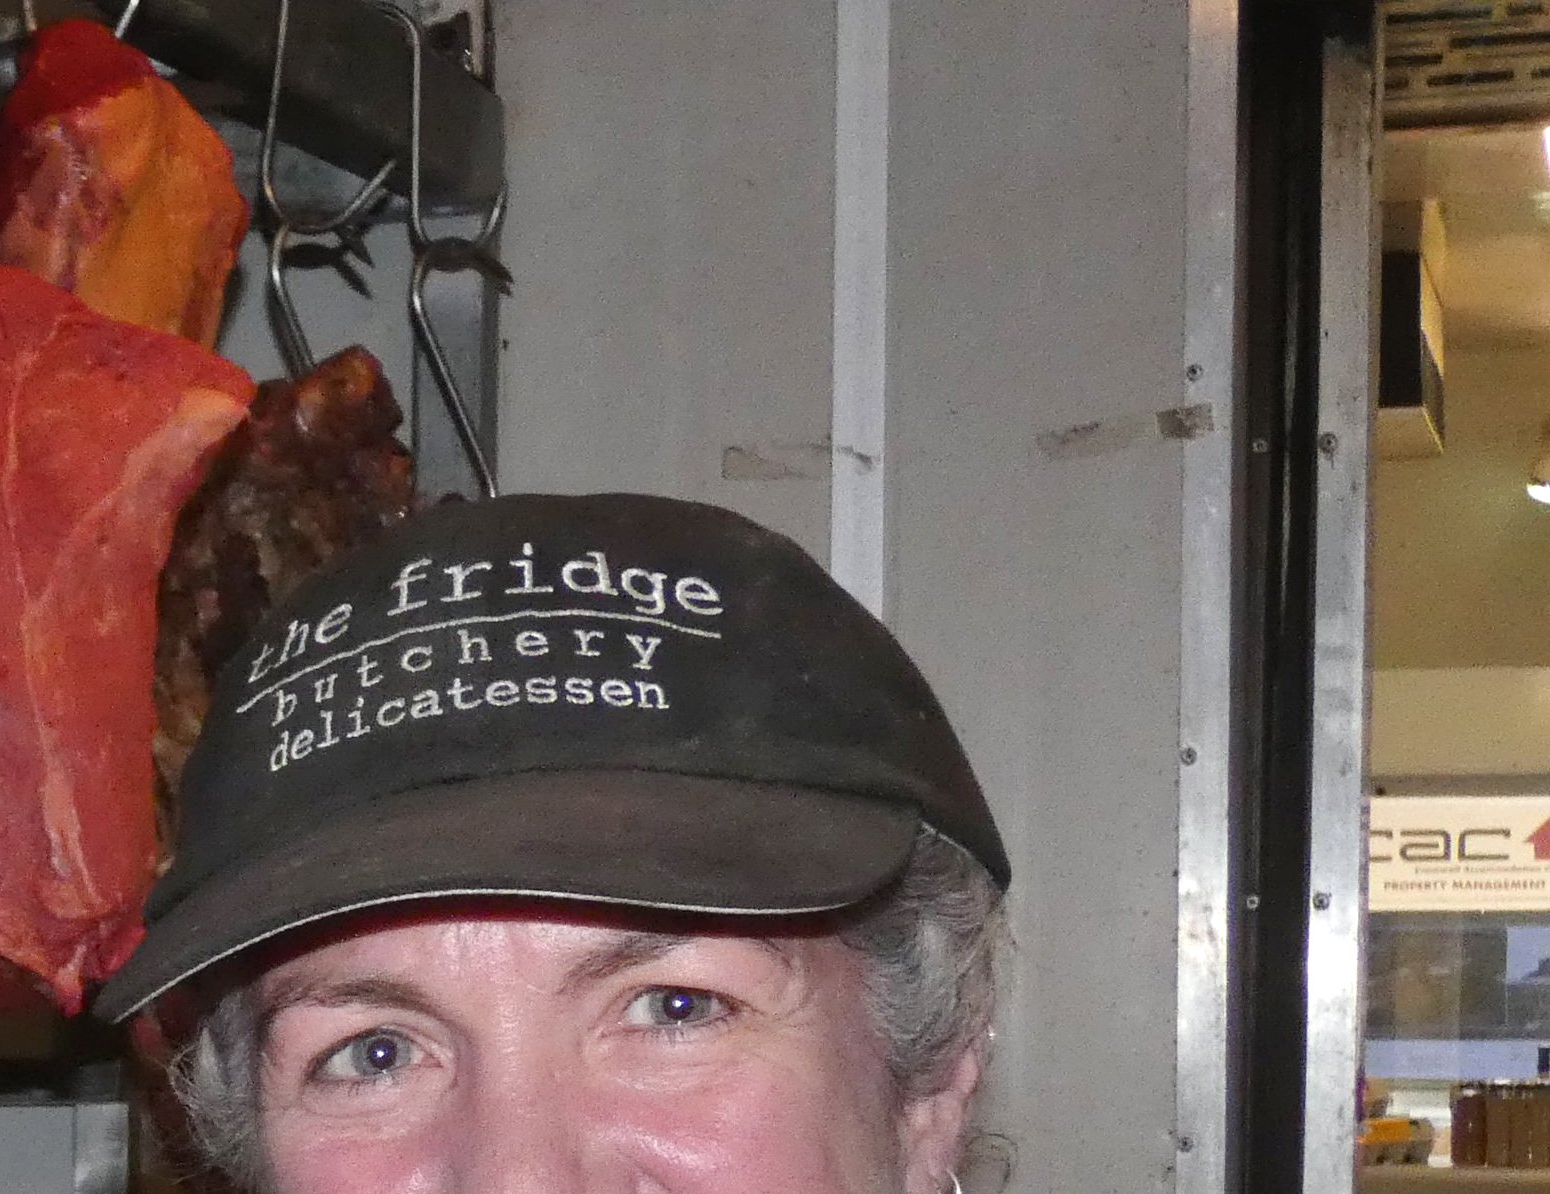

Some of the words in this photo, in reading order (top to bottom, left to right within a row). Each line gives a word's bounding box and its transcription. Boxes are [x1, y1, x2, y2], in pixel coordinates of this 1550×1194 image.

[248, 603, 353, 684] the
[386, 541, 725, 617] fridge
[269, 676, 671, 773] delicatessen
[270, 627, 662, 728] butchery
